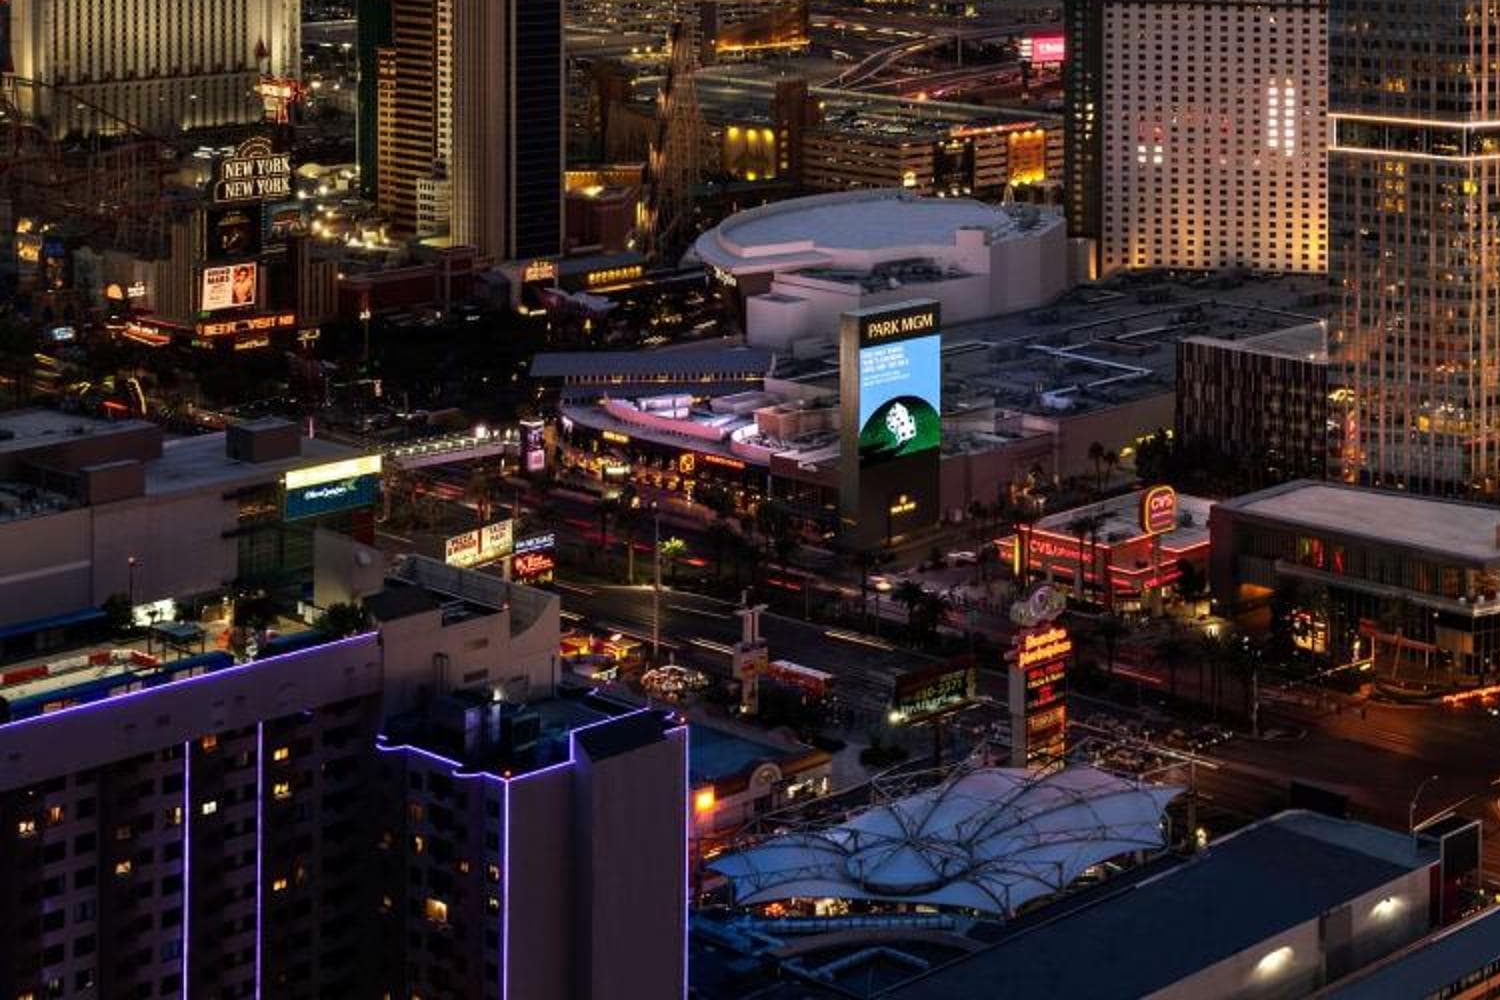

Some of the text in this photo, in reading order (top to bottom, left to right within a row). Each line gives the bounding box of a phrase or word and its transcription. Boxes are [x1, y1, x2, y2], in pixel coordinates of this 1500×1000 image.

[225, 156, 291, 179] NEW YORK
[225, 177, 291, 199] NEW YORK
[868, 312, 933, 338] PARK MGM
